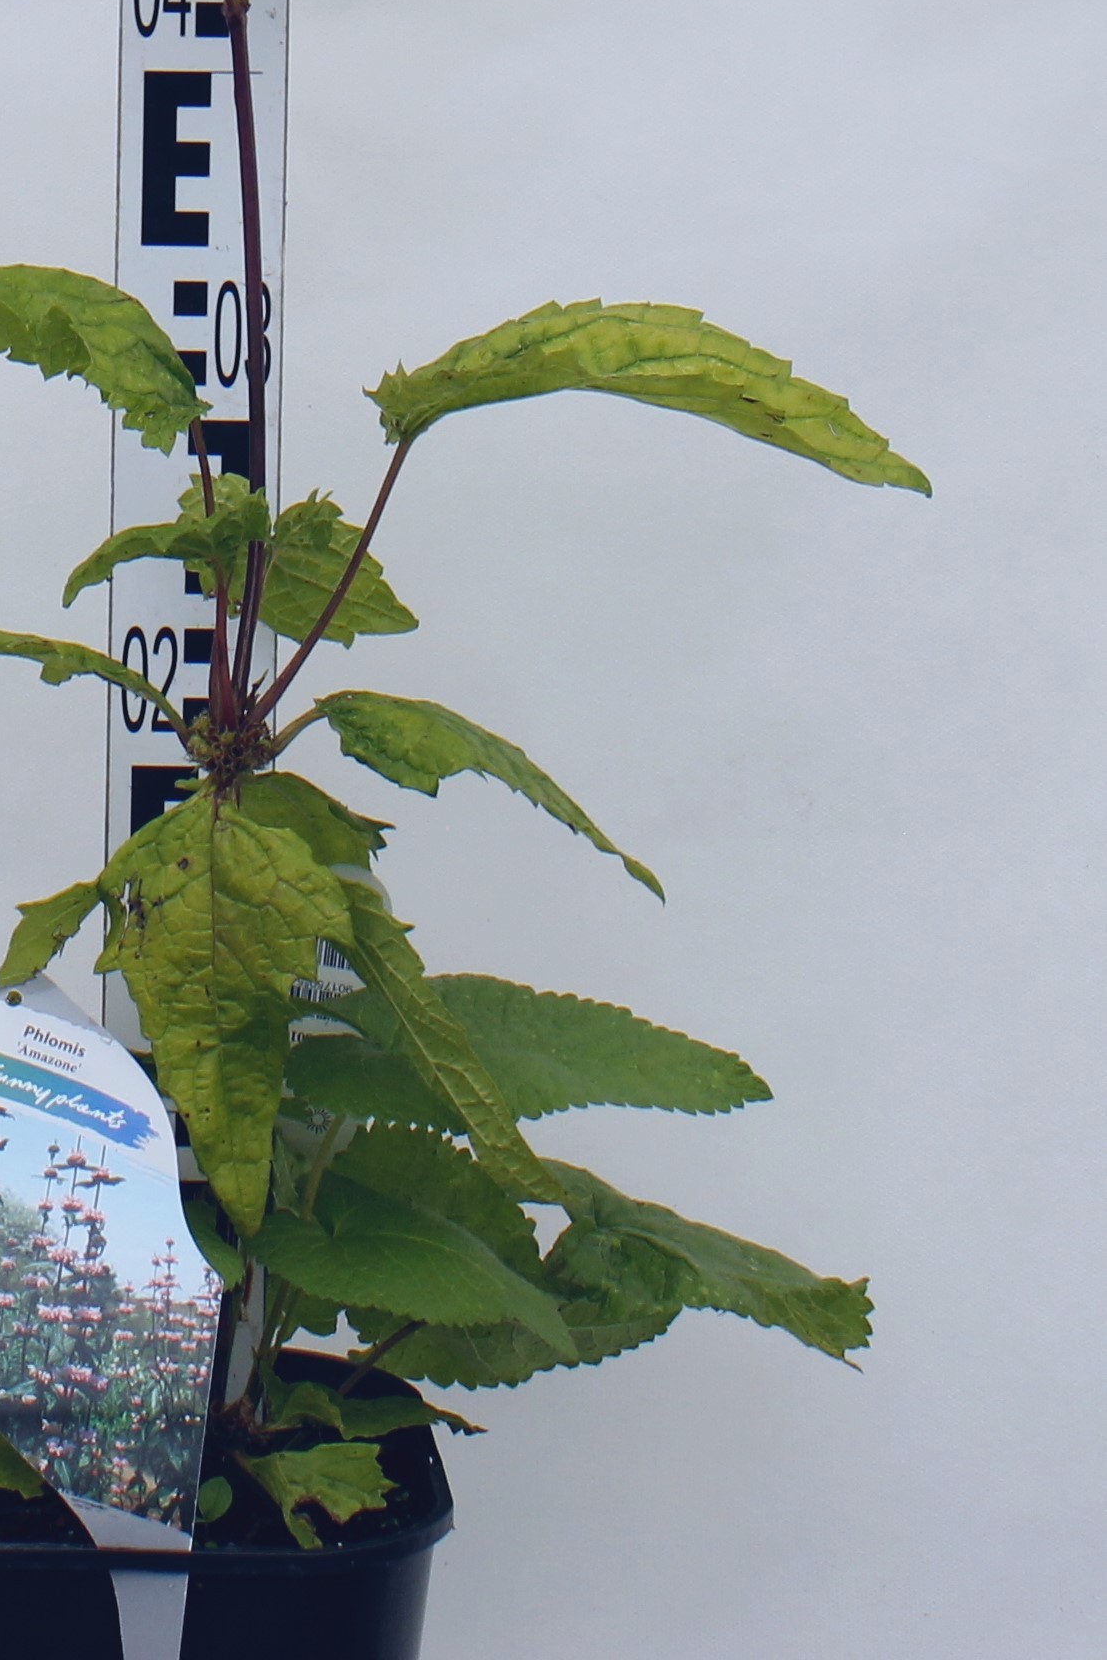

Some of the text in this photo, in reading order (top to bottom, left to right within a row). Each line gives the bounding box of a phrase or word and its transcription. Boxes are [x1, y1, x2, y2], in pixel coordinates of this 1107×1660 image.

[121, 626, 178, 733] 02
[17, 1041, 83, 1073] 'Amazone'
[23, 1024, 86, 1058] Phlomis
[44, 1092, 128, 1130] plants
